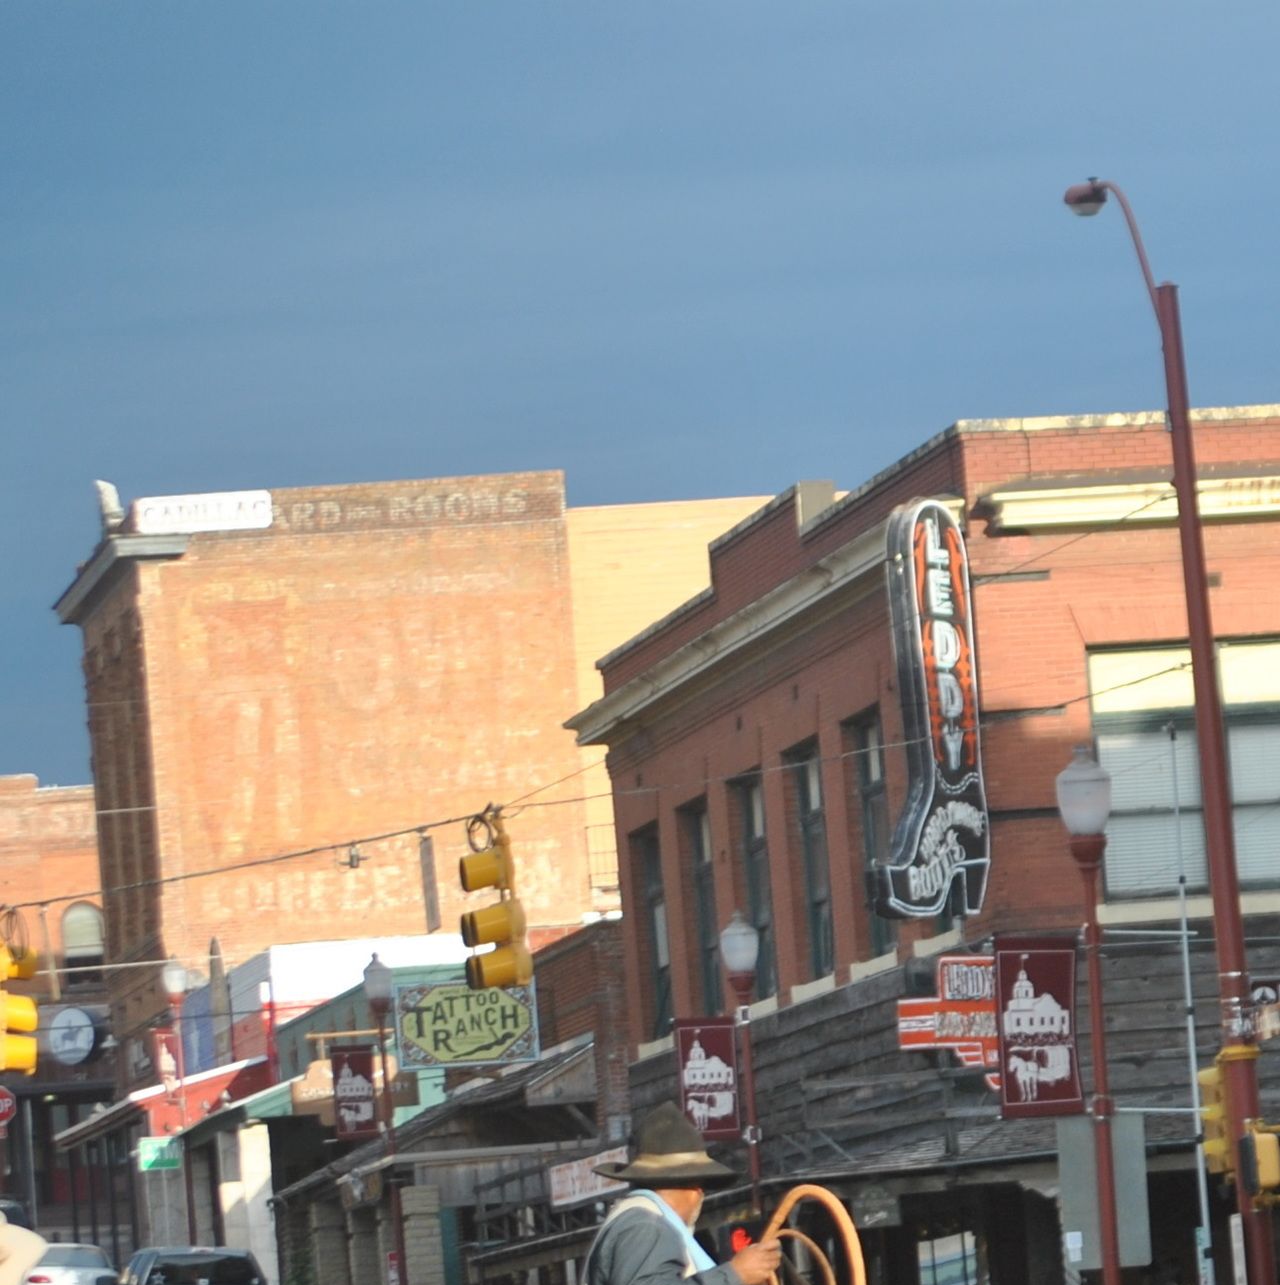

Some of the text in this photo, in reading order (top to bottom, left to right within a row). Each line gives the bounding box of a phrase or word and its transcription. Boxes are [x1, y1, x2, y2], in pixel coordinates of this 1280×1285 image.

[389, 488, 528, 523] ROOMS
[925, 518, 964, 770] LEDDY
[405, 991, 500, 1038] TATTOO
[432, 1003, 520, 1053] RANCH
